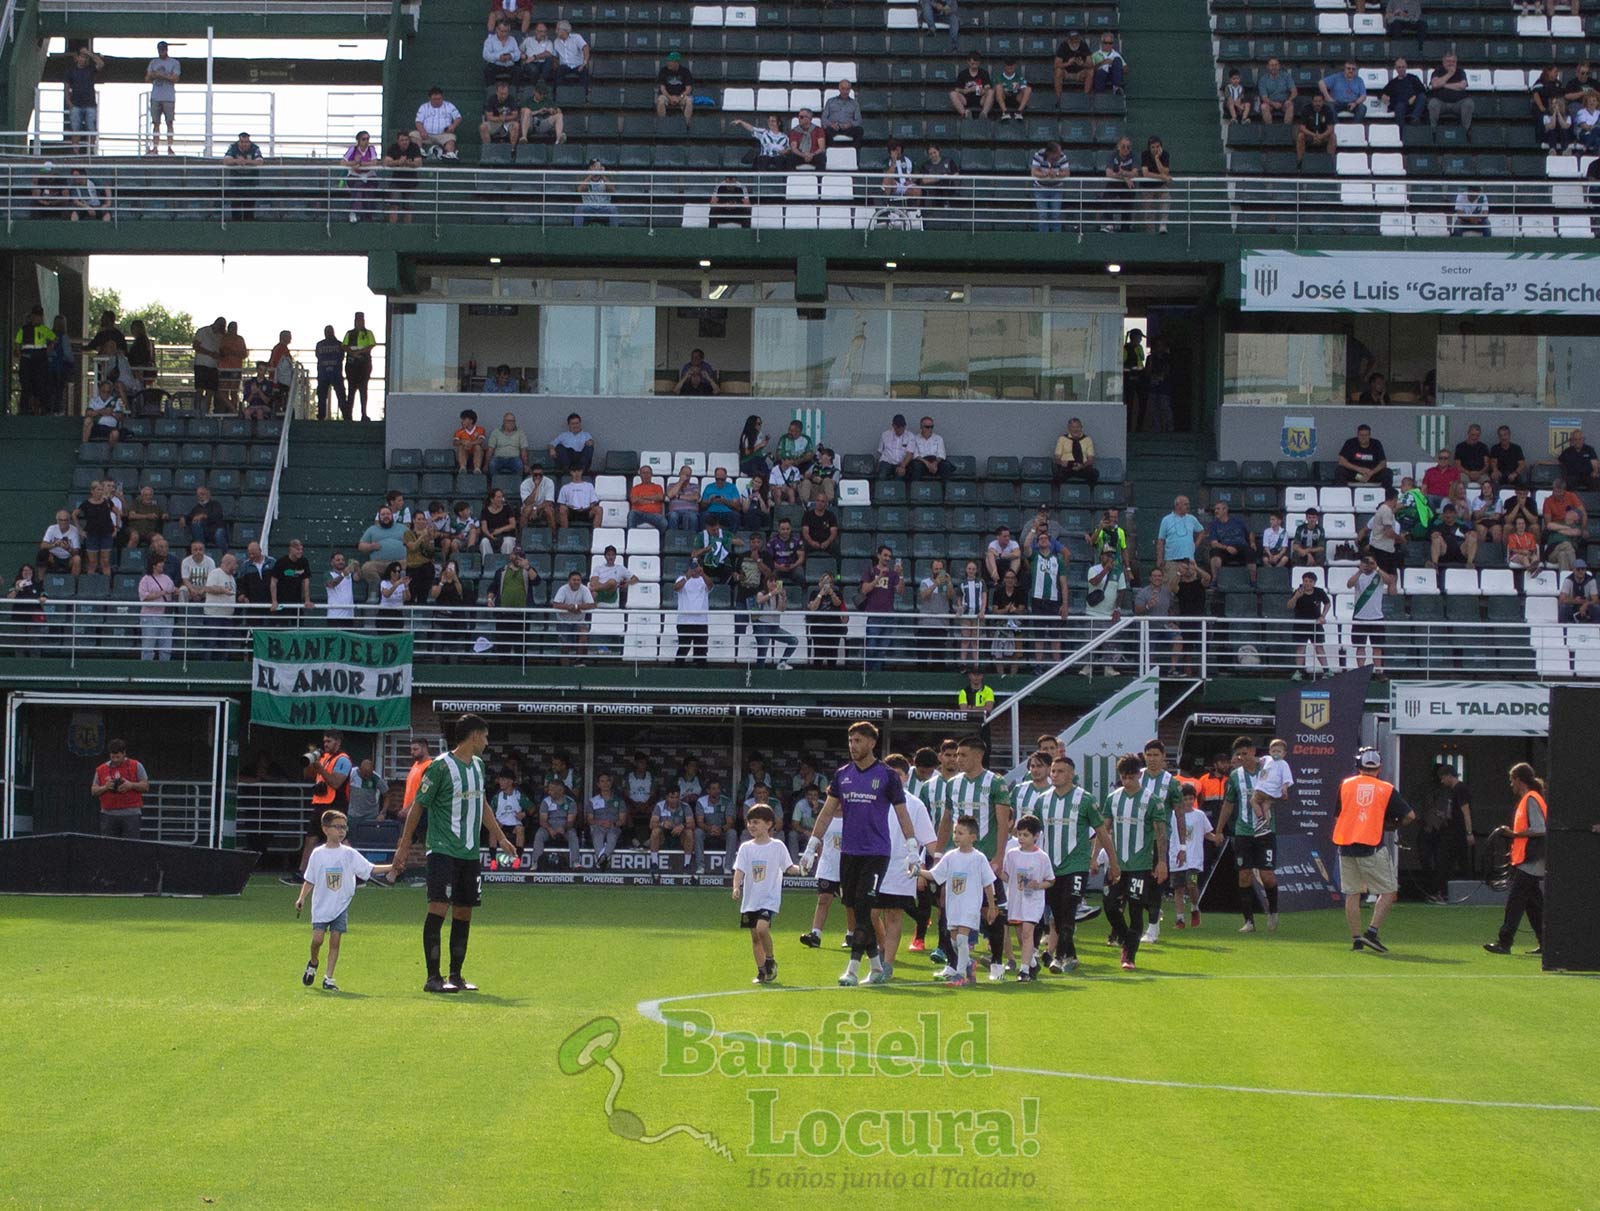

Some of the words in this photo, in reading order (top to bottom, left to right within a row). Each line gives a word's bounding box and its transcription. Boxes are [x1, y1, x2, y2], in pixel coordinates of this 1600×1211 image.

[1441, 265, 1472, 275] Sector
[1291, 279, 1346, 300] José
[1354, 280, 1399, 300] Luis
[267, 636, 399, 665] BANFIELD
[257, 664, 280, 691] EL
[292, 668, 366, 695] AMOR
[376, 669, 404, 697] DE
[442, 702, 502, 712] POWERADE
[518, 703, 578, 713] POWERADE
[593, 704, 653, 715] POWERADE
[670, 706, 730, 716] POWERADE
[746, 707, 807, 717] POWERADE
[823, 709, 883, 719] POWERADE
[1430, 701, 1452, 715] EL
[1456, 702, 1550, 716] TALADRO
[289, 702, 317, 724] MI
[327, 701, 379, 727] VIDA
[907, 711, 968, 721] POWERADE
[1202, 716, 1263, 725] POWERADE
[1296, 734, 1335, 743] TORNEO
[1293, 744, 1335, 755] Betano
[1266, 849, 1273, 862] 9
[583, 876, 625, 884] POWERADE
[873, 873, 879, 890] 1
[1073, 875, 1083, 891] 5
[1129, 878, 1144, 895] 34
